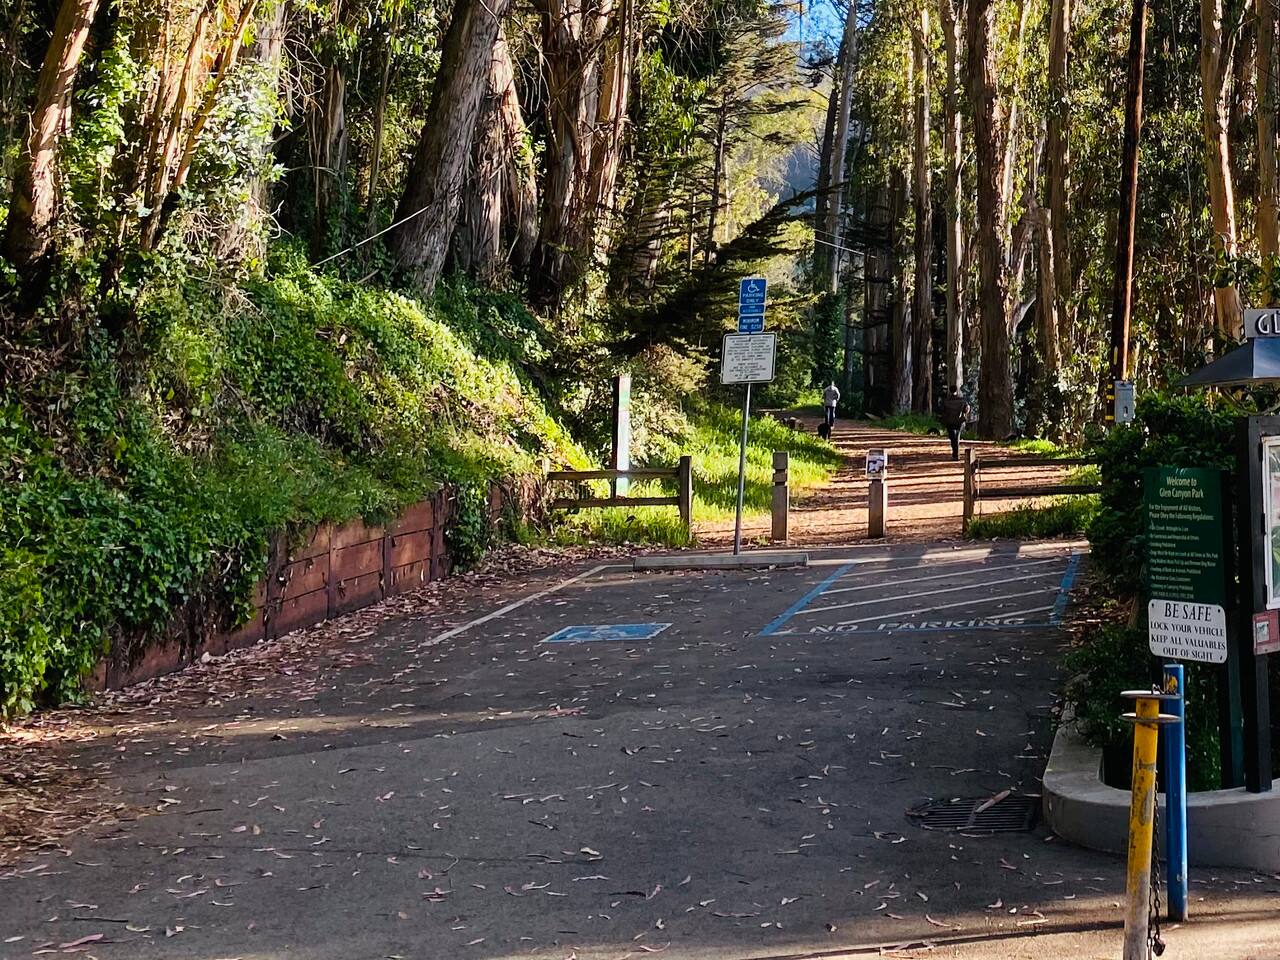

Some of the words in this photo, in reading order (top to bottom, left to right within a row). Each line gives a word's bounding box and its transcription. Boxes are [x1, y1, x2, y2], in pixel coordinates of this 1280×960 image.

[1166, 476, 1190, 487] Welcome
[1191, 477, 1197, 487] to
[1159, 487, 1172, 498] Glen
[1172, 487, 1191, 500] Canyon
[1192, 488, 1204, 498] Park
[1164, 602, 1179, 618] BE
[1183, 604, 1212, 622] SAFE
[810, 624, 859, 633] NO
[877, 618, 1026, 631] PARKING
[1150, 621, 1169, 631] LOCK
[1171, 623, 1192, 633] YOUR
[1194, 626, 1224, 637] VEHICLE
[1151, 634, 1168, 643] KEEP
[1171, 636, 1181, 645] ALL
[1185, 638, 1226, 650] VALUABLES
[1163, 647, 1178, 656] OUT
[1180, 649, 1189, 658] OF
[1191, 650, 1213, 660] SIGHT
